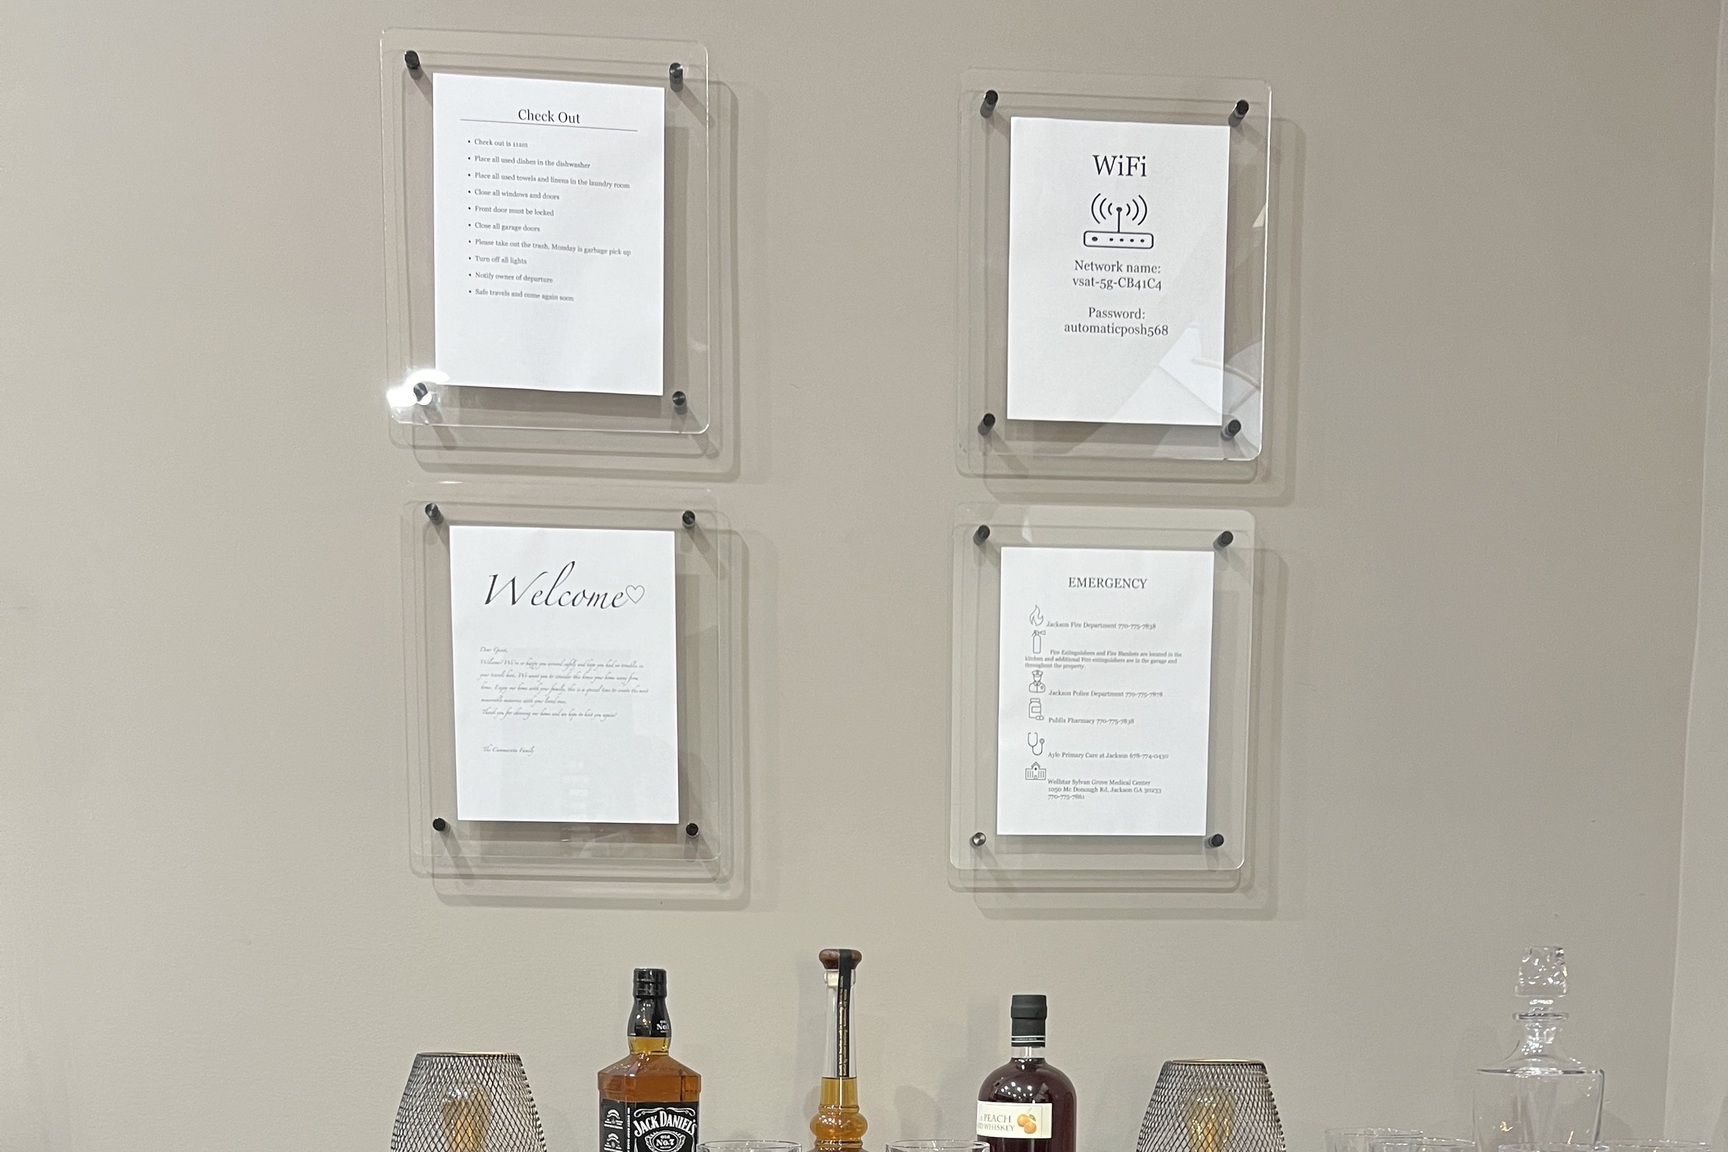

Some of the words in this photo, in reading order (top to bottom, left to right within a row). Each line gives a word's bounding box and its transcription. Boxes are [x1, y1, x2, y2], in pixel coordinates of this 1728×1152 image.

[518, 108, 555, 123] Check
[558, 112, 580, 124] Out
[556, 160, 590, 169] dishwasher
[1092, 154, 1147, 177] WiFi
[550, 176, 569, 184] linens
[570, 177, 576, 185] in
[578, 178, 588, 186] the
[589, 179, 613, 189] laundry
[551, 243, 576, 253] Monday
[584, 246, 608, 255] garbage
[609, 248, 621, 256] pick
[510, 257, 527, 265] lights
[1074, 260, 1123, 273] Network
[1126, 264, 1161, 274] name:
[475, 272, 494, 280] Notify
[523, 275, 553, 283] departure
[1072, 276, 1162, 291] vsat-5g-CB41C4
[1088, 307, 1146, 320] Password:
[1064, 323, 1169, 337] automaticposh568
[484, 560, 629, 609] Welcome
[1068, 577, 1148, 589] EMERGENCY
[1091, 690, 1124, 698] Department
[1068, 717, 1095, 725] Pharmacy
[1073, 786, 1098, 794] Donough
[633, 1114, 660, 1137] JACK
[659, 1110, 697, 1136] DANIEL'S
[984, 1113, 1011, 1123] PEACH
[984, 1123, 1015, 1132] WHISKEY
